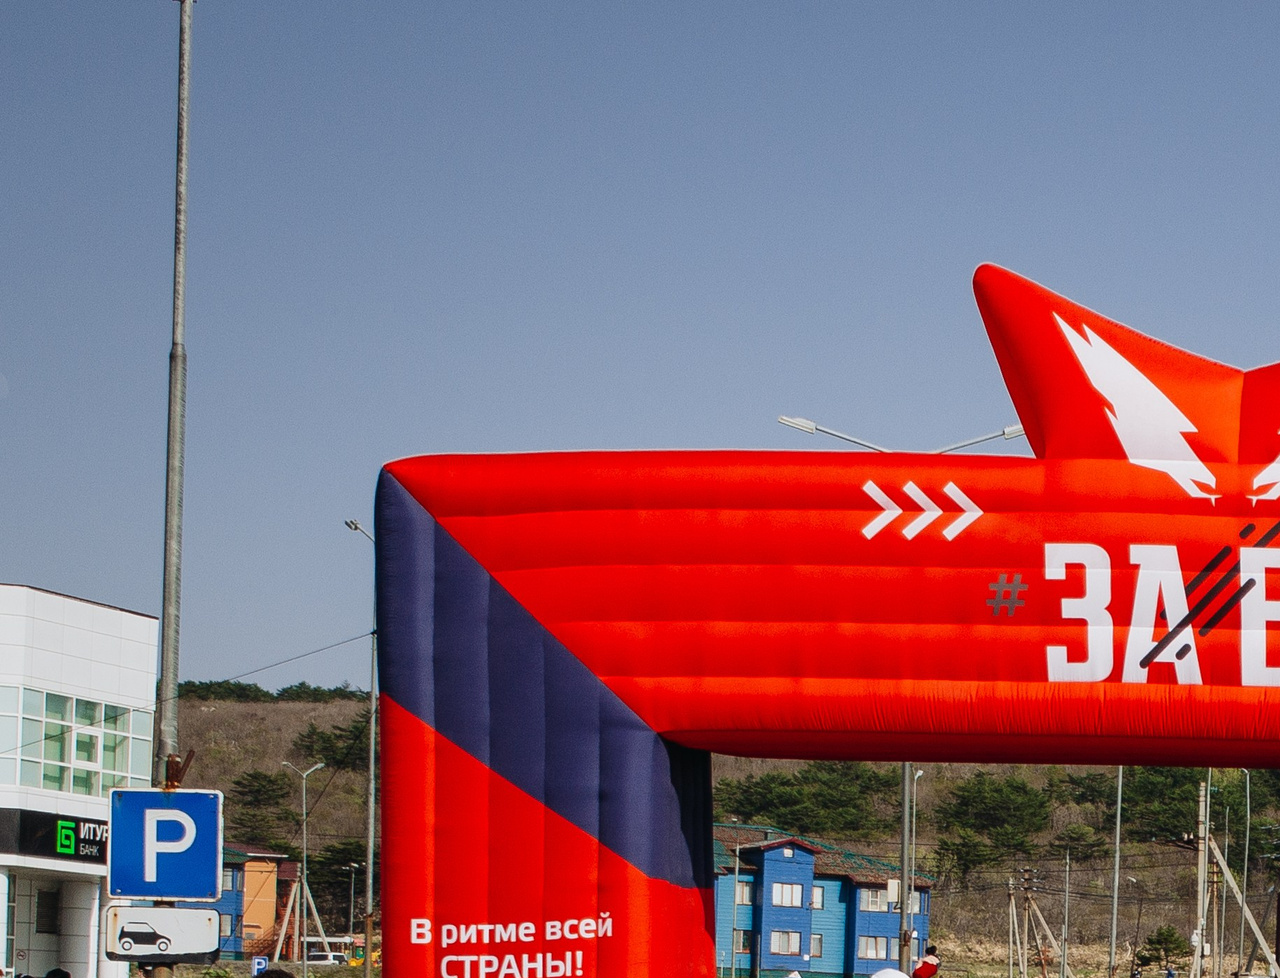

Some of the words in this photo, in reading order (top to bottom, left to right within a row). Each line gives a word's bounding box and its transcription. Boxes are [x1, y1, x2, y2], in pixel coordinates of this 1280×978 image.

[80, 843, 99, 856] БАНК
[144, 808, 197, 883] P
[410, 918, 432, 944] В
[441, 922, 536, 948] ритме
[545, 912, 613, 940] всей
[254, 958, 266, 976] P
